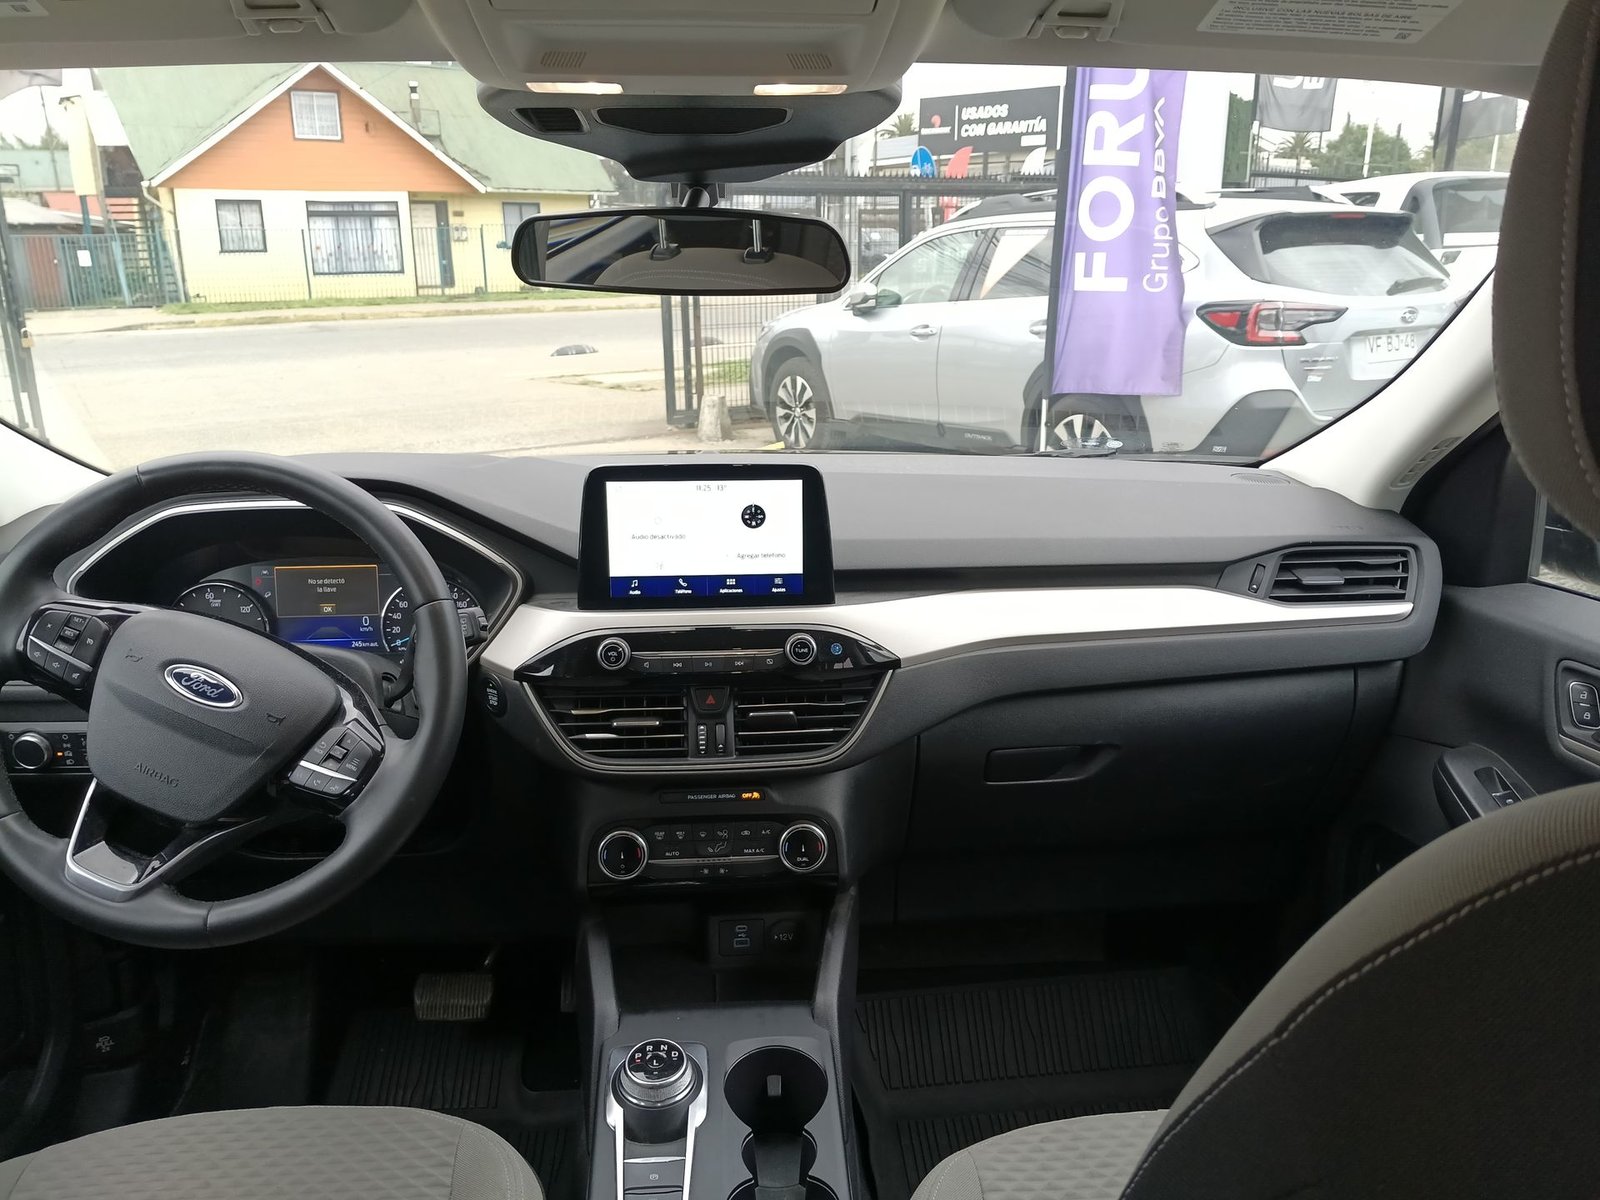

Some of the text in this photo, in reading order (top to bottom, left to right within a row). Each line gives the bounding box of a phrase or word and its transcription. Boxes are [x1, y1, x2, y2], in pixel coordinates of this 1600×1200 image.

[961, 104, 1009, 120] USADOS
[961, 123, 987, 137] CON
[987, 115, 1047, 136] GARANTÍA
[1142, 96, 1173, 293] Grupo BBVA
[737, 552, 760, 560] Agregar
[362, 615, 370, 626] 0
[182, 672, 224, 698] Ford
[134, 762, 179, 788] AIRBAG
